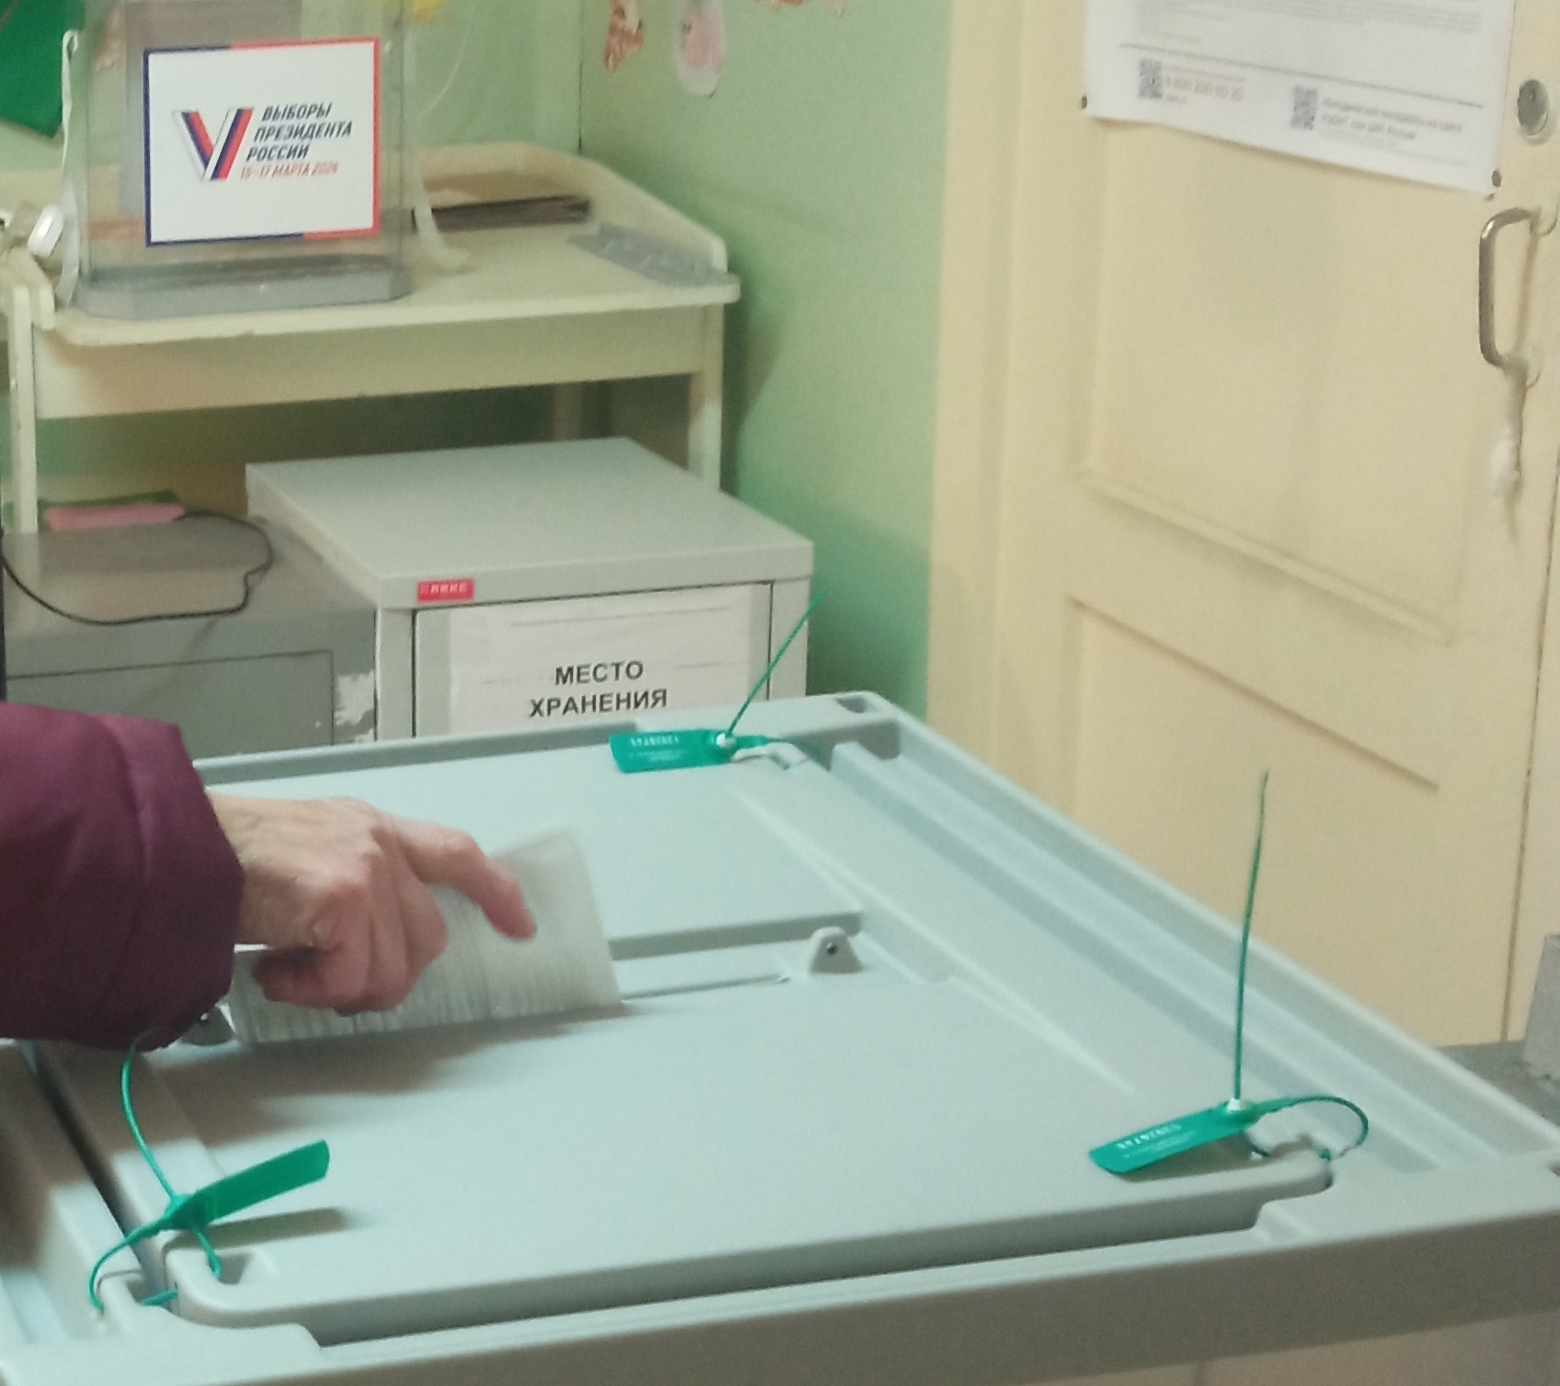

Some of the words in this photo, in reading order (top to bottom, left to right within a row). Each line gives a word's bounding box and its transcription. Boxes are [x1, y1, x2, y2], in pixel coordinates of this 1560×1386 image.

[261, 101, 332, 122] ВЫБОРЫ
[253, 120, 352, 143] ПРЕЗИДЕНТА
[245, 143, 310, 162] РОССИИ
[554, 660, 644, 686] МЕСТО
[528, 688, 668, 718] ХРАНЕНИЯ
